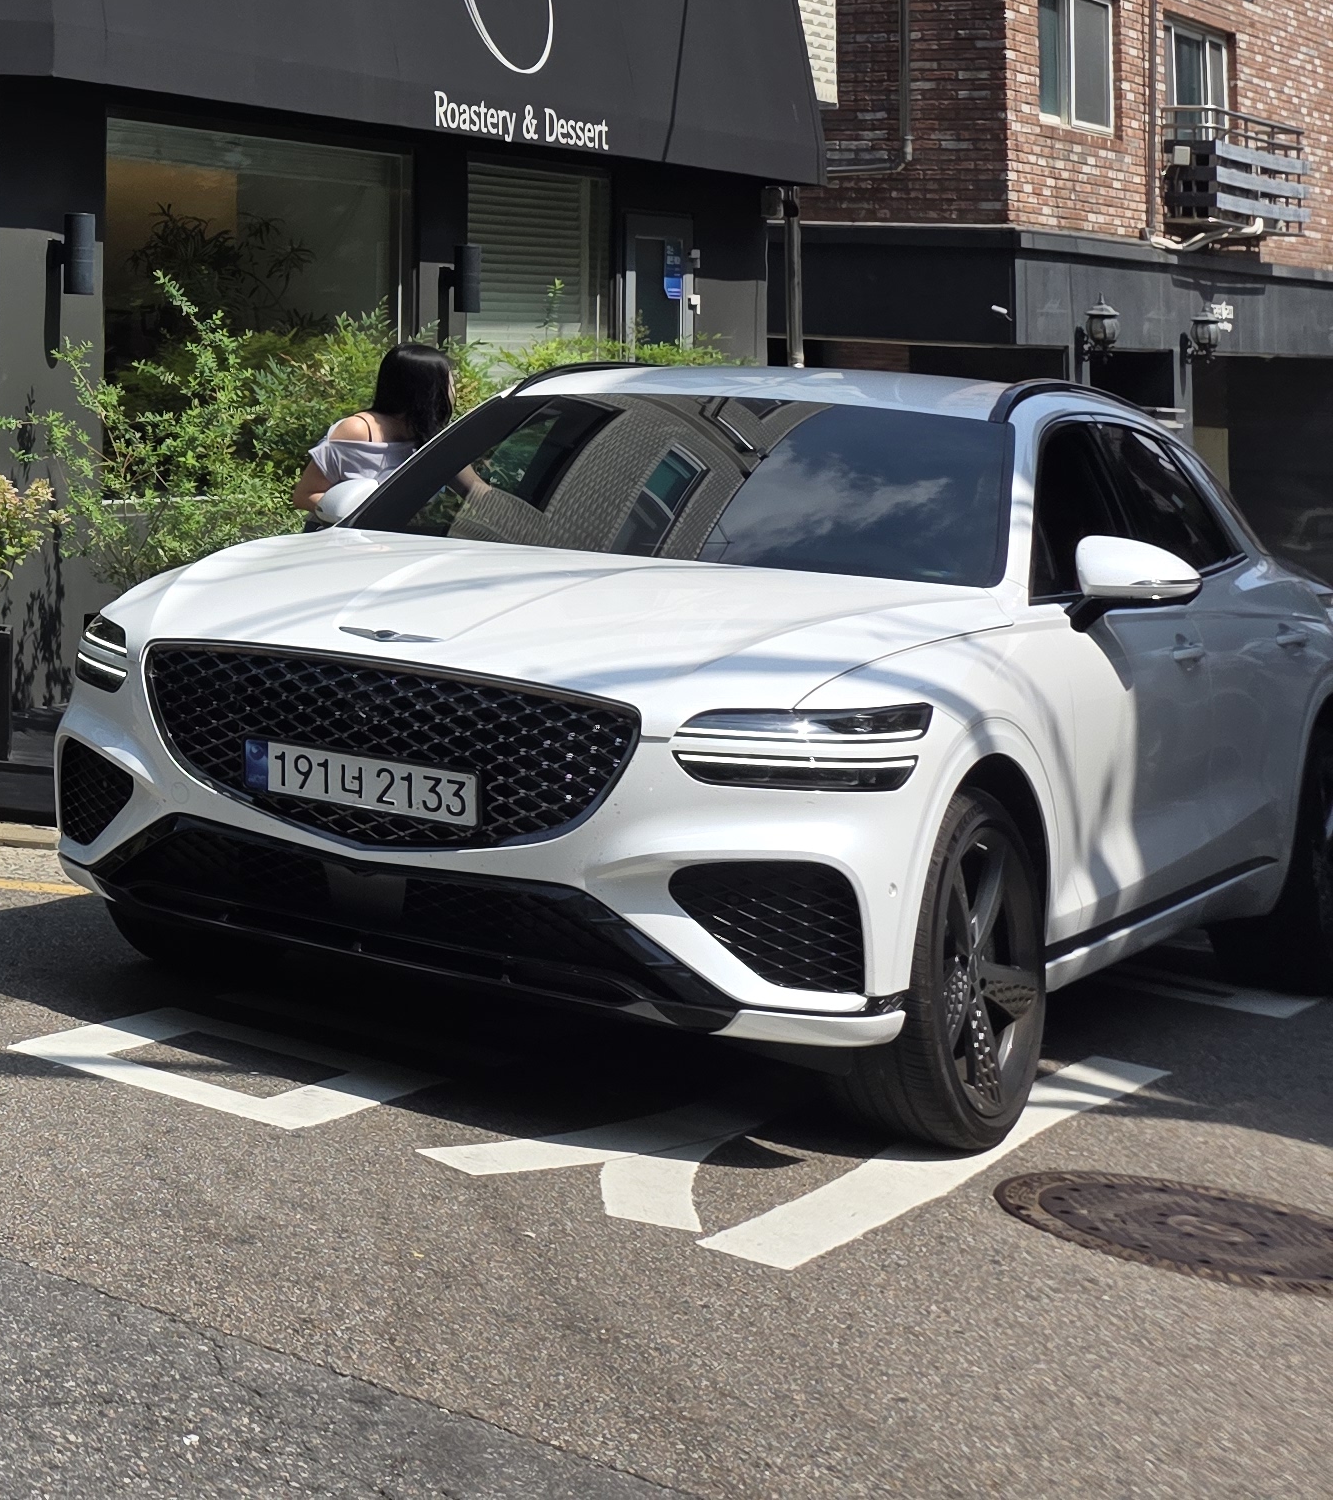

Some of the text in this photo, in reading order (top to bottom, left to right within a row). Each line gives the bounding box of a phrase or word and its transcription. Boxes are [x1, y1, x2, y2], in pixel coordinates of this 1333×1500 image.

[434, 90, 609, 151] Roastery & Dessert
[274, 750, 466, 817] 191너 2133
